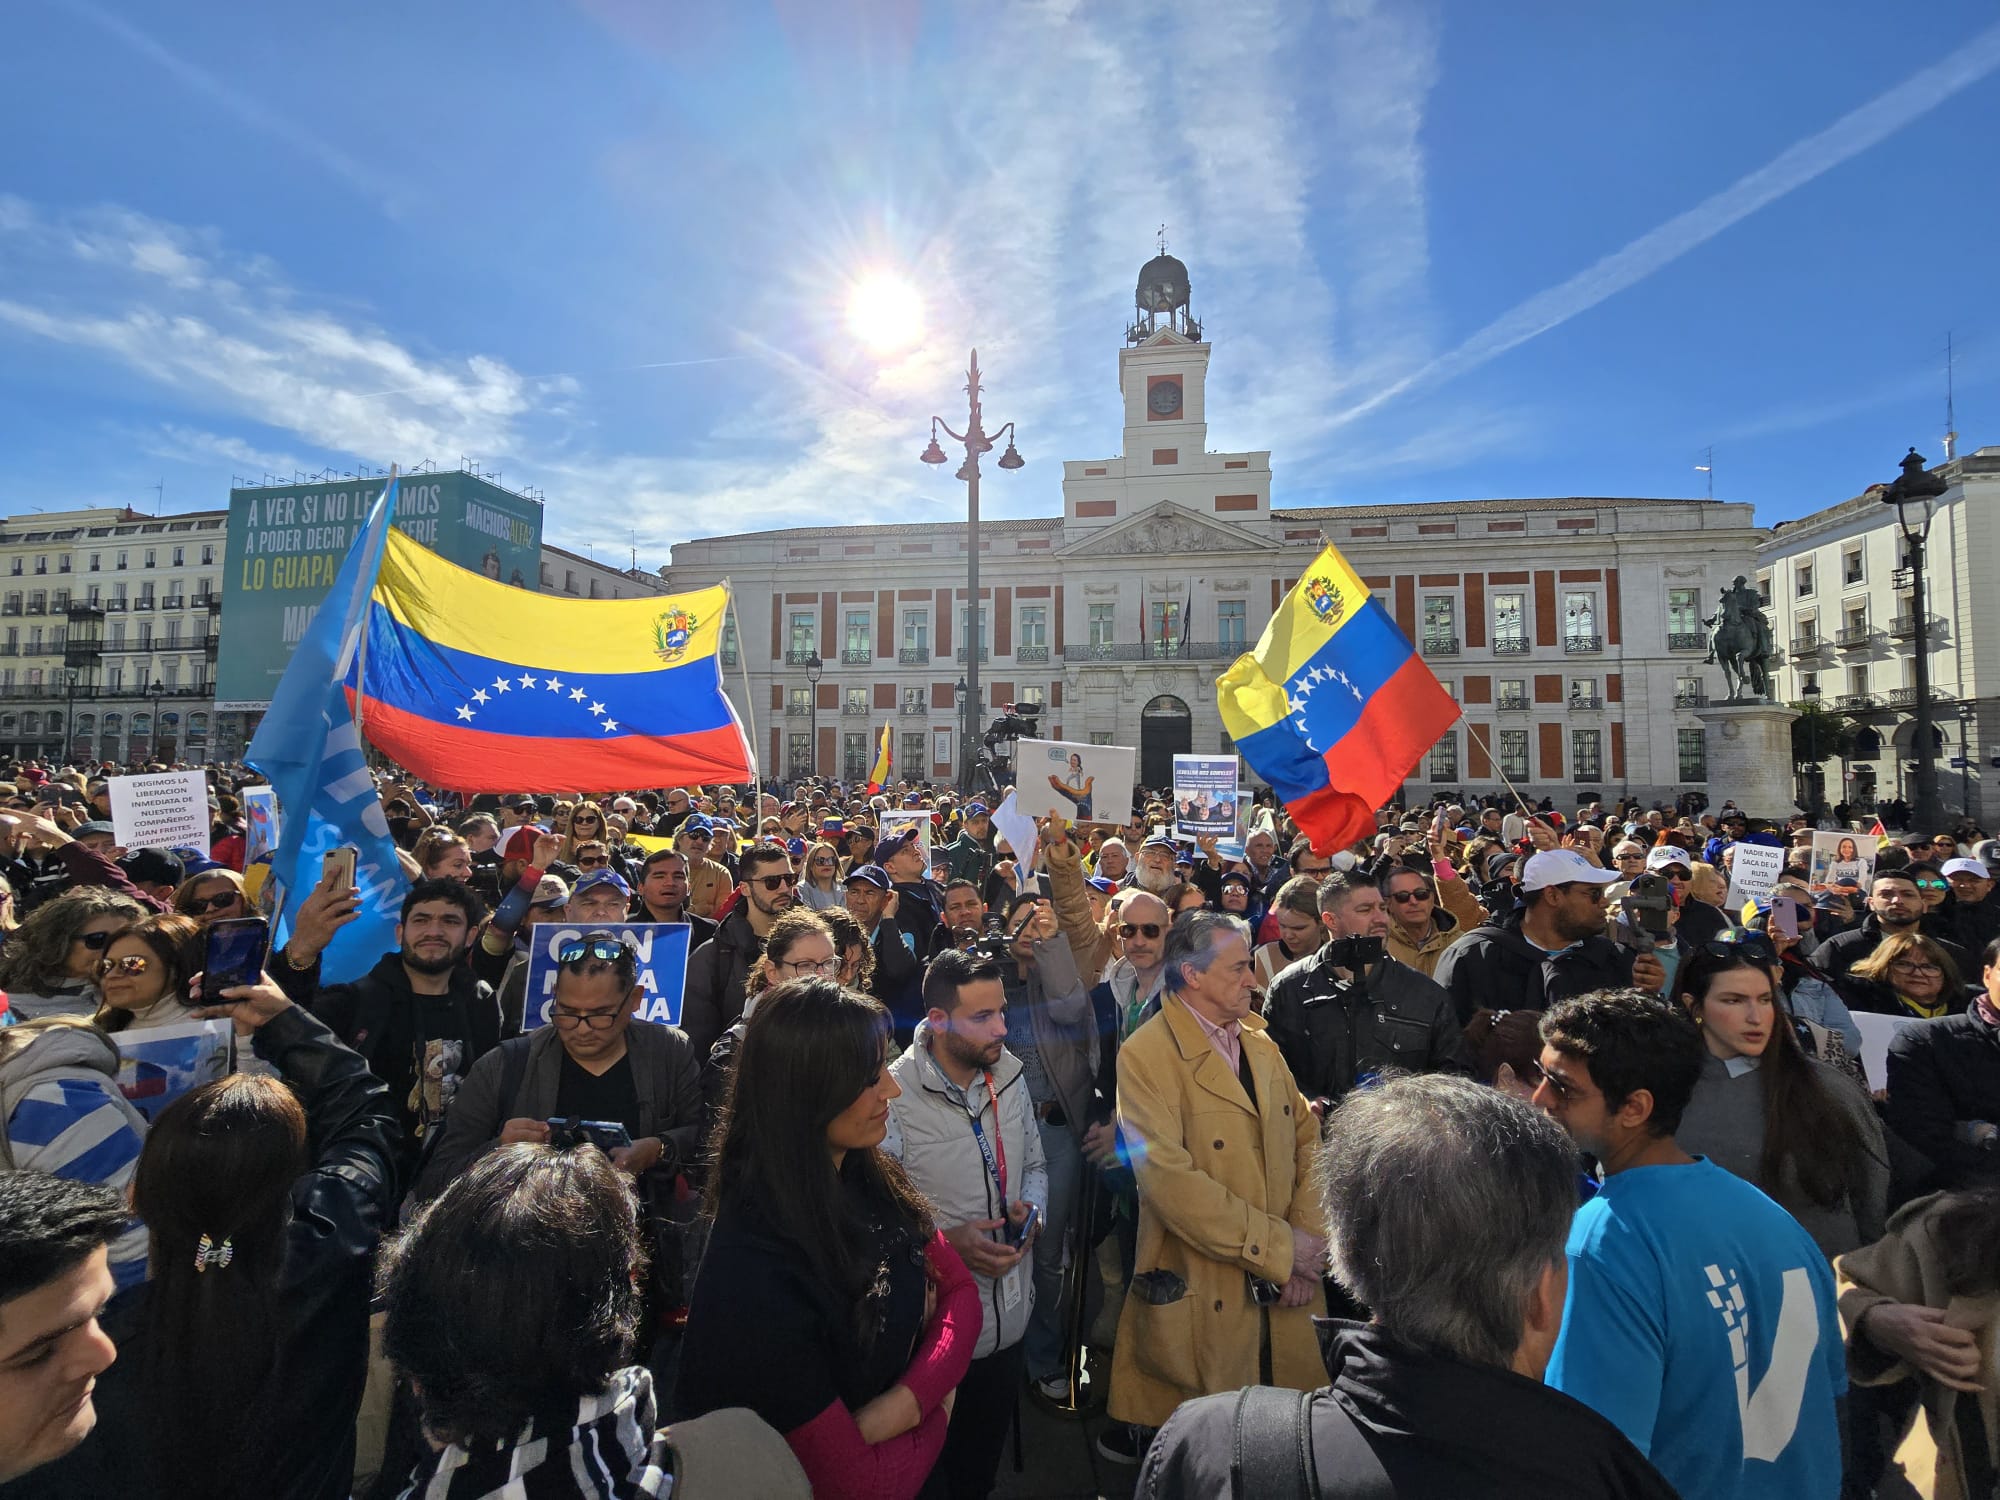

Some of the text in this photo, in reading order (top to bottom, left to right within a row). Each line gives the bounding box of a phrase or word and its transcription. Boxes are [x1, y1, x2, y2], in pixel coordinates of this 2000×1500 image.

[247, 500, 258, 528] A
[265, 496, 295, 526] VER
[302, 495, 319, 524] SI
[324, 492, 348, 522] NO
[245, 532, 254, 554] A
[258, 528, 302, 553] PODER
[306, 526, 346, 550] DECIR
[242, 554, 335, 591] LO GUAPA
[132, 779, 176, 788] EXIGIMOS
[135, 787, 187, 798] LIBERACION
[131, 798, 180, 808] INMEDIATA
[141, 806, 187, 817] NUESTROS
[134, 815, 195, 827] COMPAÑEROS
[134, 828, 158, 838] JUAN
[159, 824, 192, 834] FREITES
[125, 836, 176, 848] GUILLERMO
[1743, 848, 1779, 859] NADIE NOS
[1742, 858, 1760, 867] SACA
[1751, 870, 1769, 878] RUTA
[1739, 878, 1775, 889] ELECTORA
